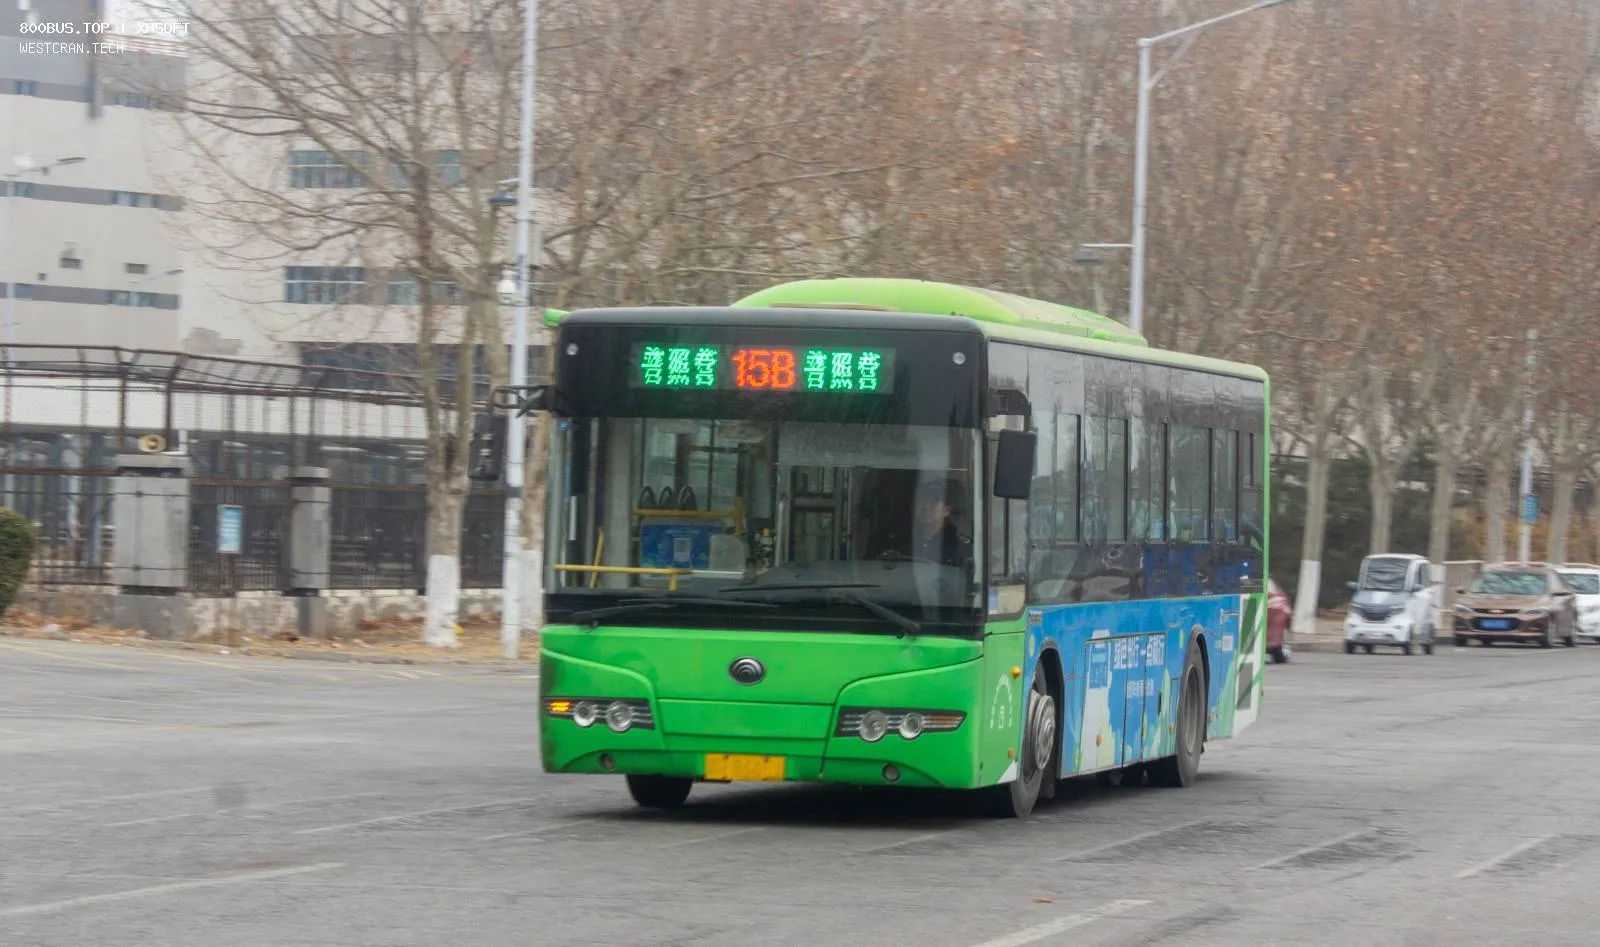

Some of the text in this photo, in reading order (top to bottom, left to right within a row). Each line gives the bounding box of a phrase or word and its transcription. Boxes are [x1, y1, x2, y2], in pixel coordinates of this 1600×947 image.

[641, 346, 881, 390] 普照营 15B 普照营
